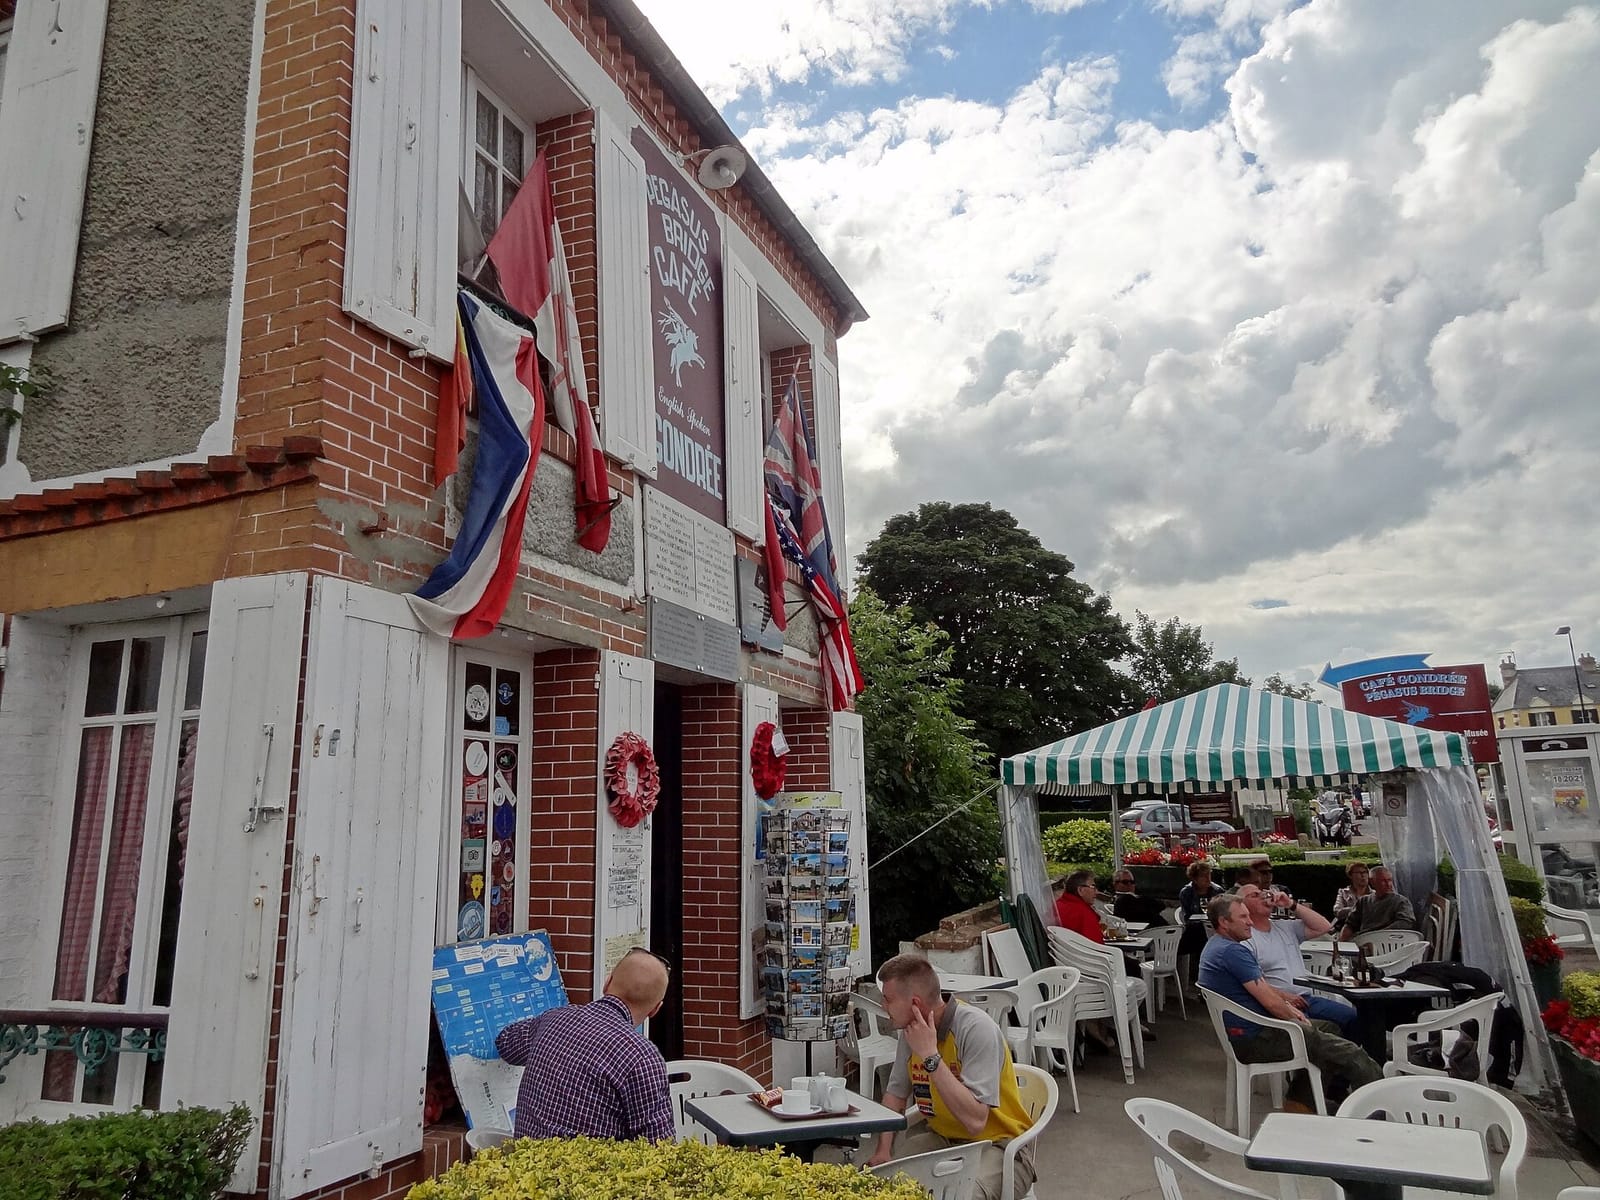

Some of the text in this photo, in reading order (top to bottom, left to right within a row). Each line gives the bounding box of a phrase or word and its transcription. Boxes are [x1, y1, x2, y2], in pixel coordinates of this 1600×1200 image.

[646, 174, 709, 255] PEGASUS
[661, 213, 715, 301] BRIDGE
[658, 385, 711, 436] English Spoken
[1359, 672, 1467, 691] CAFÉ GONDRÉE
[1419, 686, 1466, 697] BRIDGE
